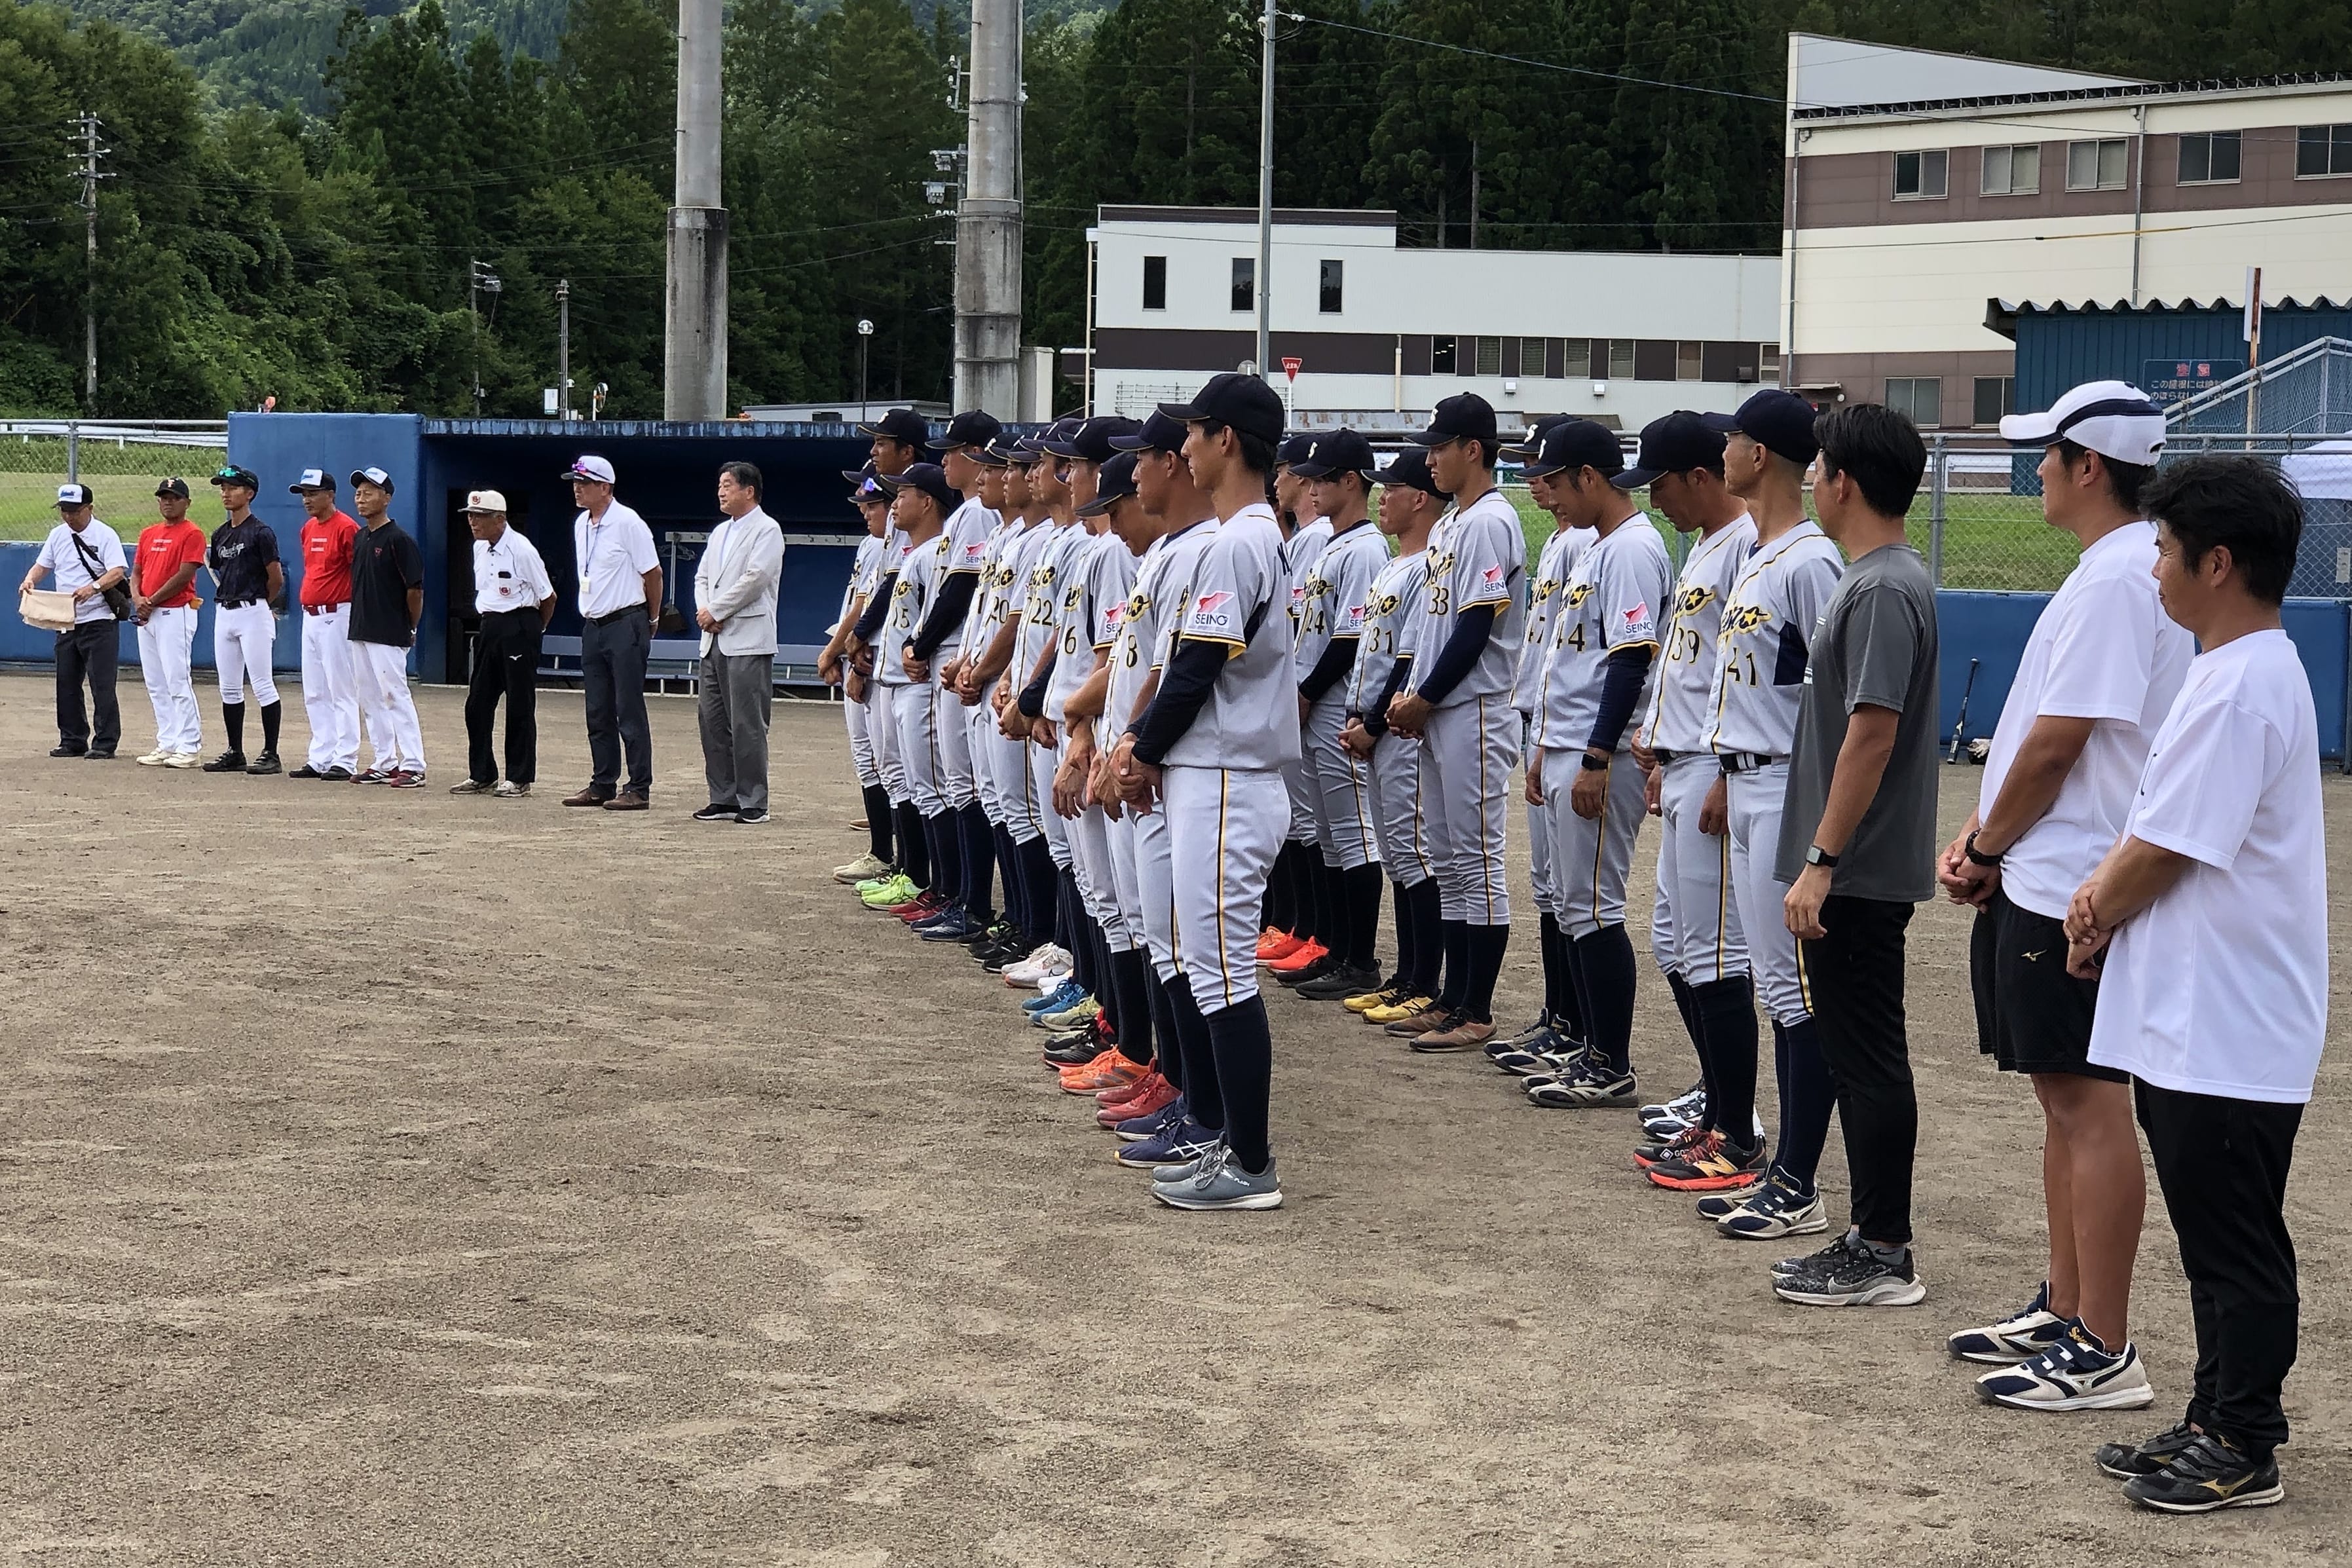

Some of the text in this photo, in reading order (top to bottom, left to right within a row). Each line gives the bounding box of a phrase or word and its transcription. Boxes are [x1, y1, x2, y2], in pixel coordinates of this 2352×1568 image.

[1428, 587, 1449, 615] 33
[1485, 582, 1505, 593] SEIN
[1031, 597, 1053, 626] 22
[1195, 613, 1229, 625] SEINO
[1065, 625, 1076, 654] 6
[1127, 635, 1138, 668] 8
[1370, 627, 1392, 654] 31
[1671, 627, 1700, 664] 39
[1727, 647, 1757, 686] 41
